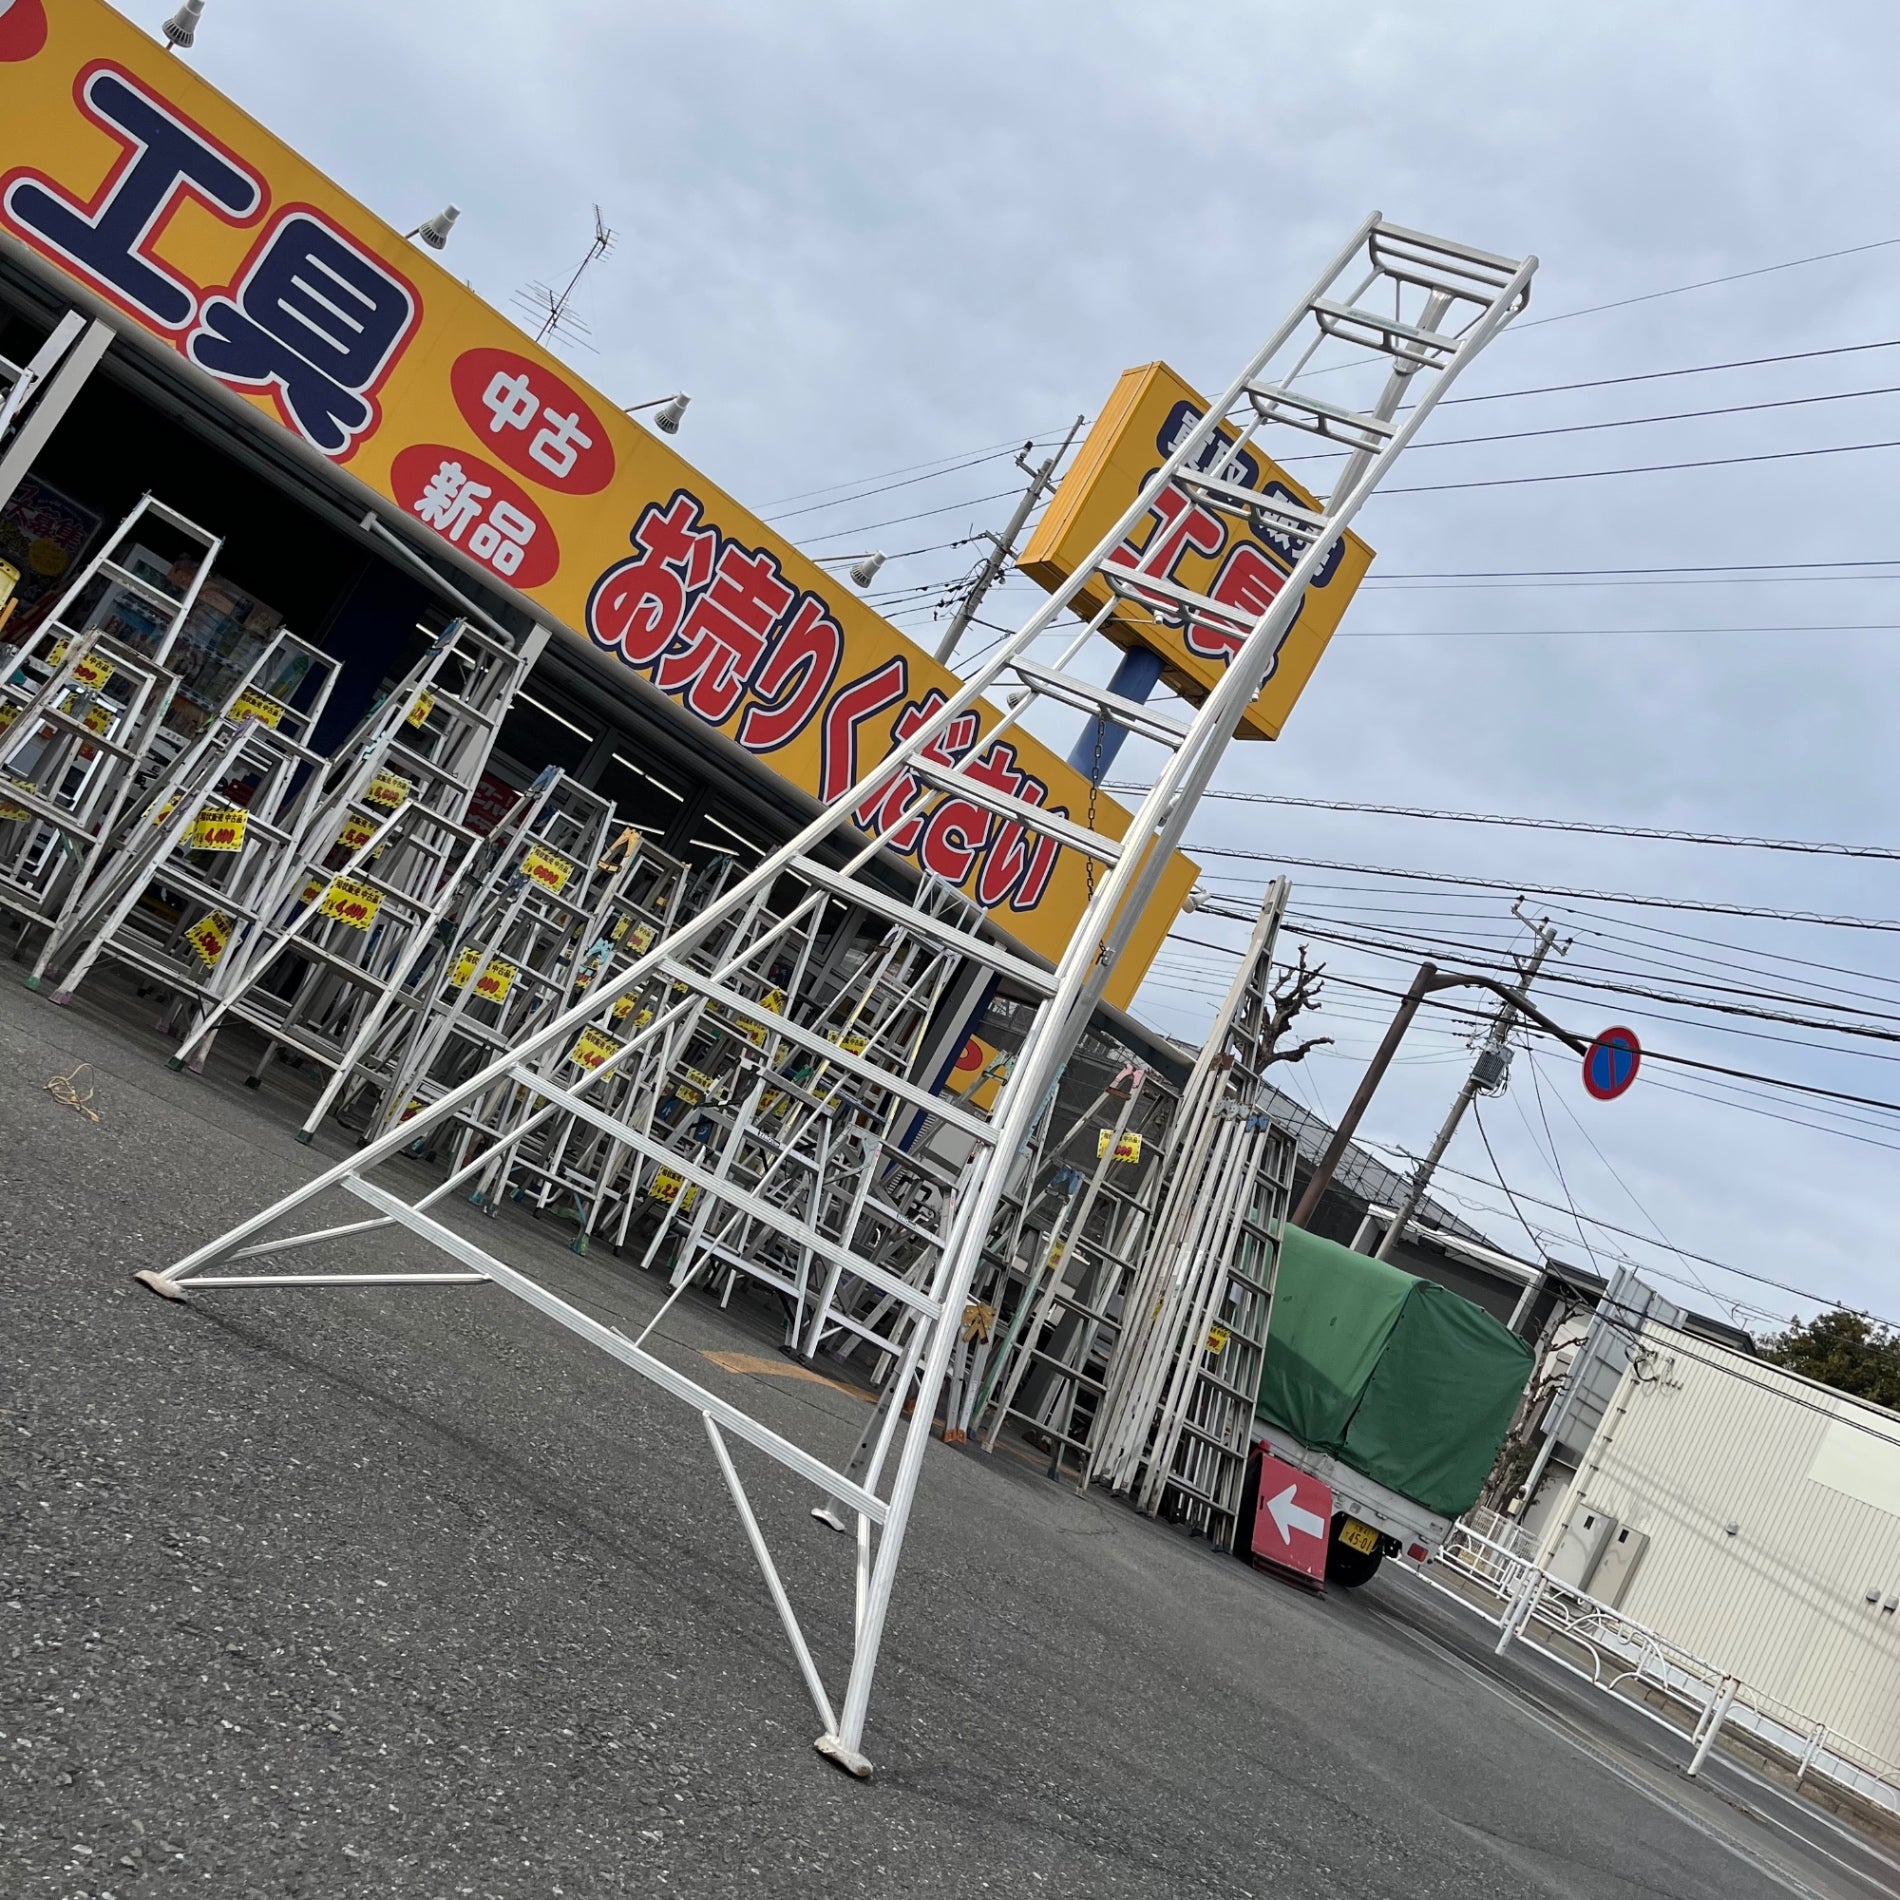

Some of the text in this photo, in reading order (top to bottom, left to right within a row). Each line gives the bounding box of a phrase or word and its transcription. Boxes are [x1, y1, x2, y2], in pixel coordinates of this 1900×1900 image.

[3, 68, 416, 457] 工具
[413, 461, 537, 577] 新品
[482, 370, 593, 479] 中古
[590, 491, 1065, 908] お売りください
